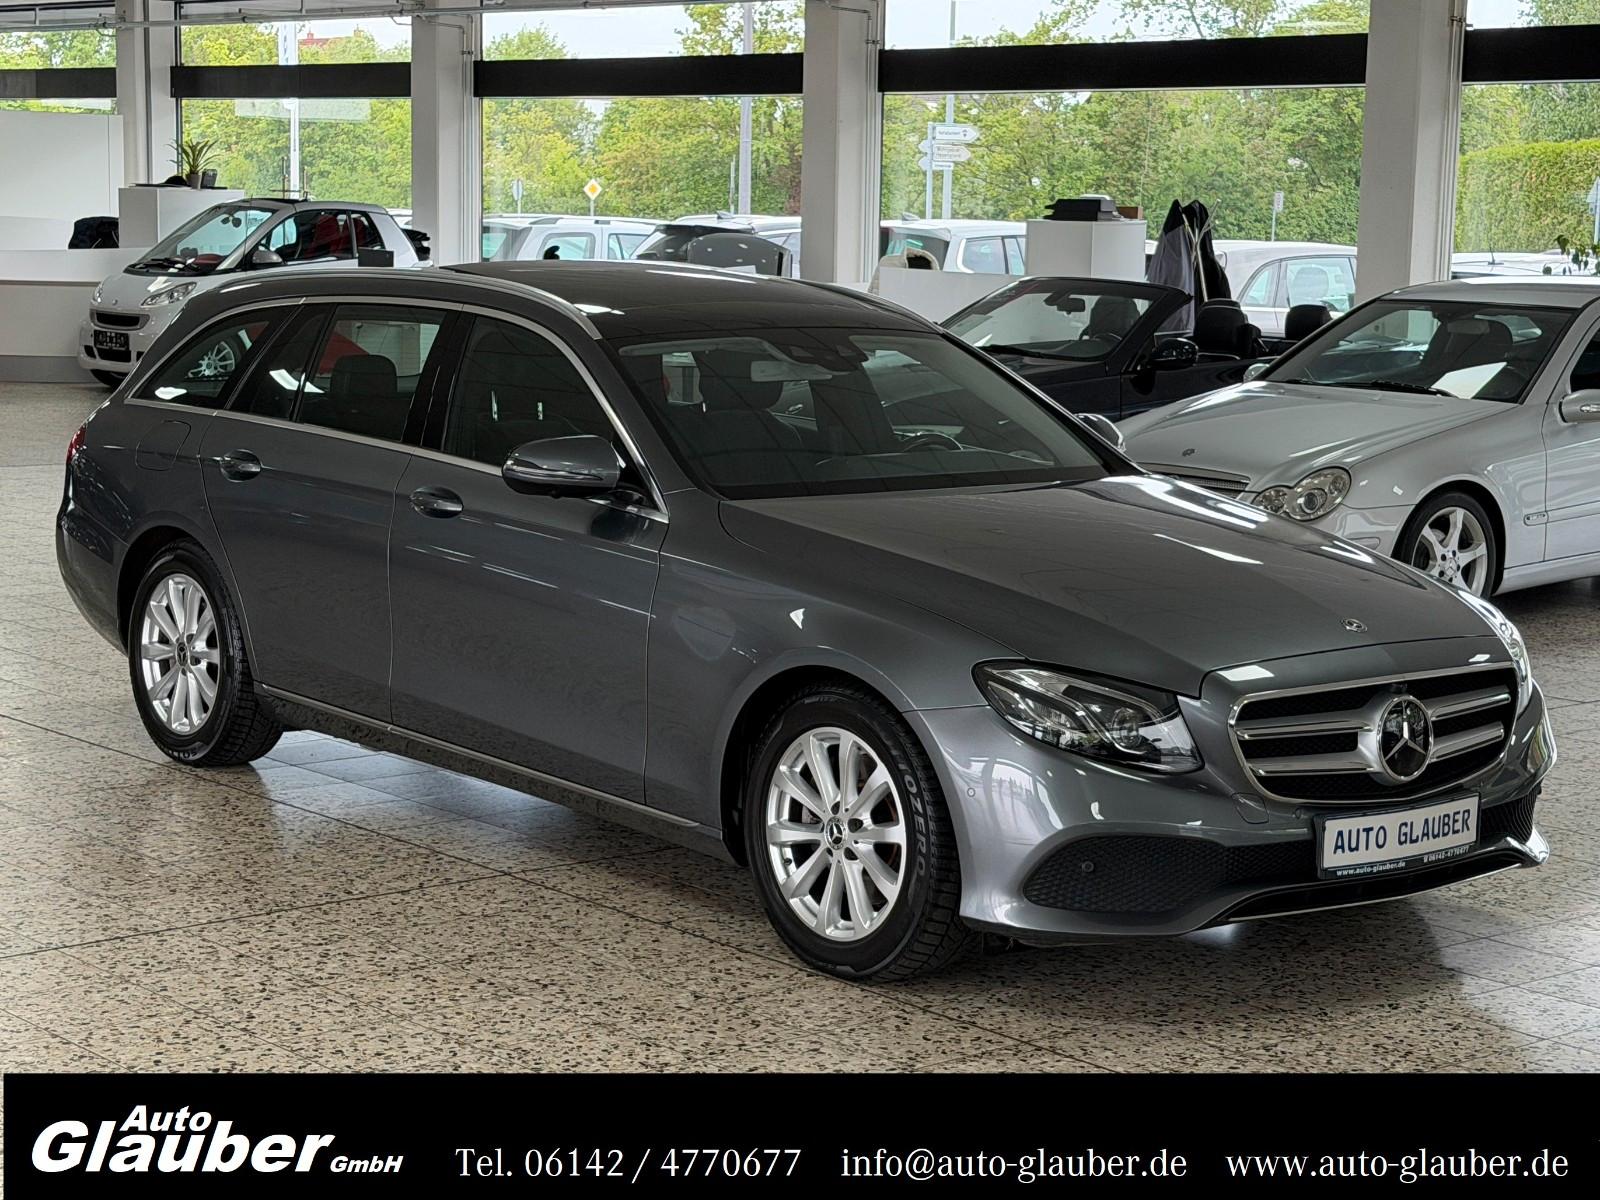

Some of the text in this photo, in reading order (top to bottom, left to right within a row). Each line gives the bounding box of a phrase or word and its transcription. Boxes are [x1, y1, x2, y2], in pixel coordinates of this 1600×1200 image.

[1333, 808, 1471, 855] AUTO GLAUBER
[1336, 861, 1406, 876] www.auto-glauber.de
